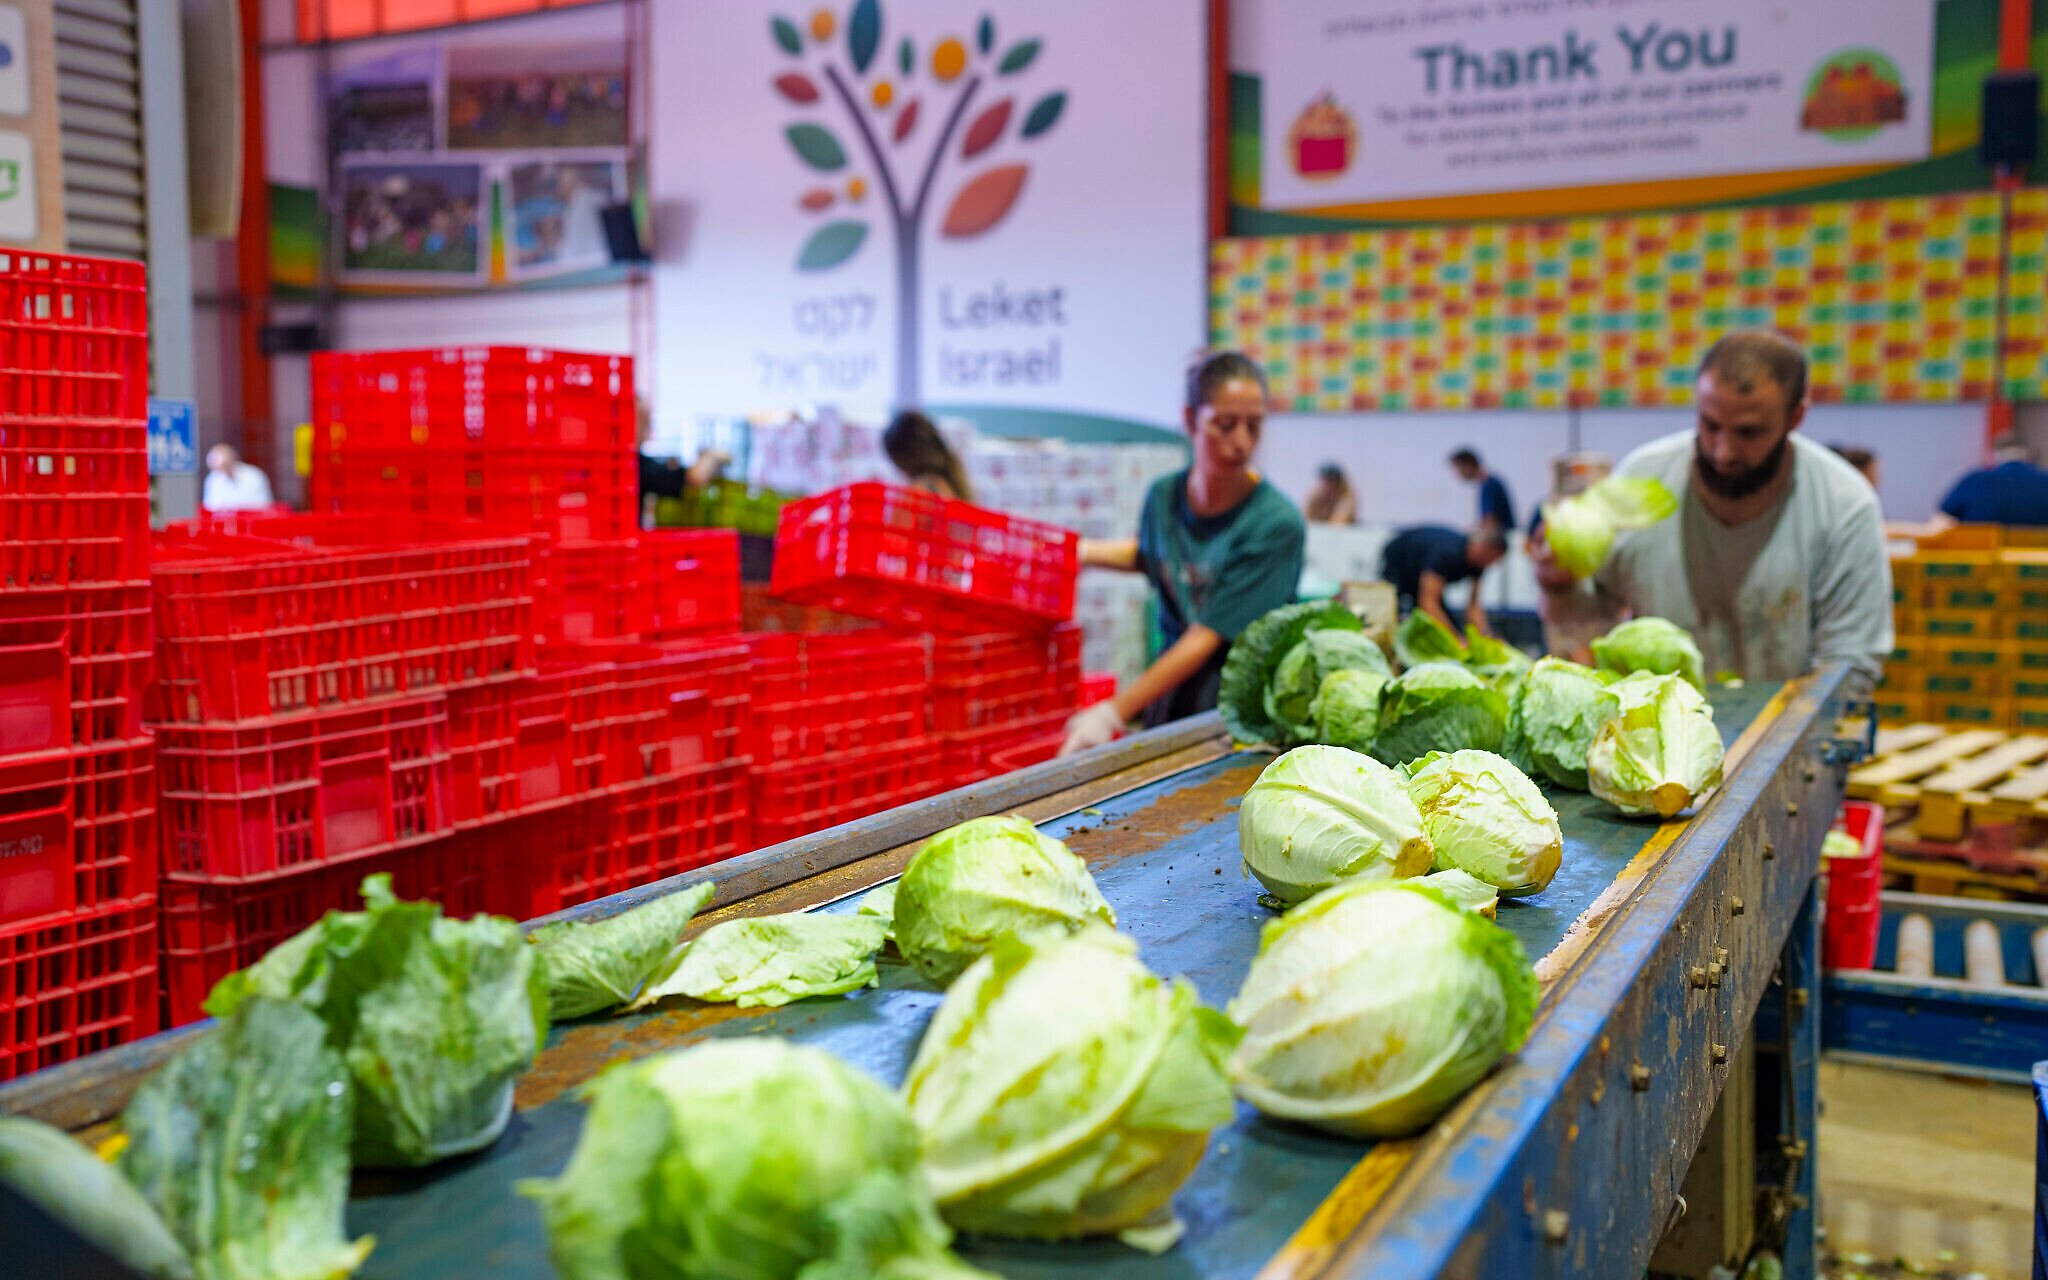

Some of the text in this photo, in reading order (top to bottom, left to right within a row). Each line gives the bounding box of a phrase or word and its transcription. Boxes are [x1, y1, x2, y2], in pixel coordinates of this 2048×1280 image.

[1416, 23, 1737, 93] Thank You
[1448, 99, 1523, 117] farmers
[1532, 94, 1568, 110] and
[1684, 75, 1781, 97] partners
[941, 284, 1066, 329] Leket
[942, 339, 1062, 387] Israel
